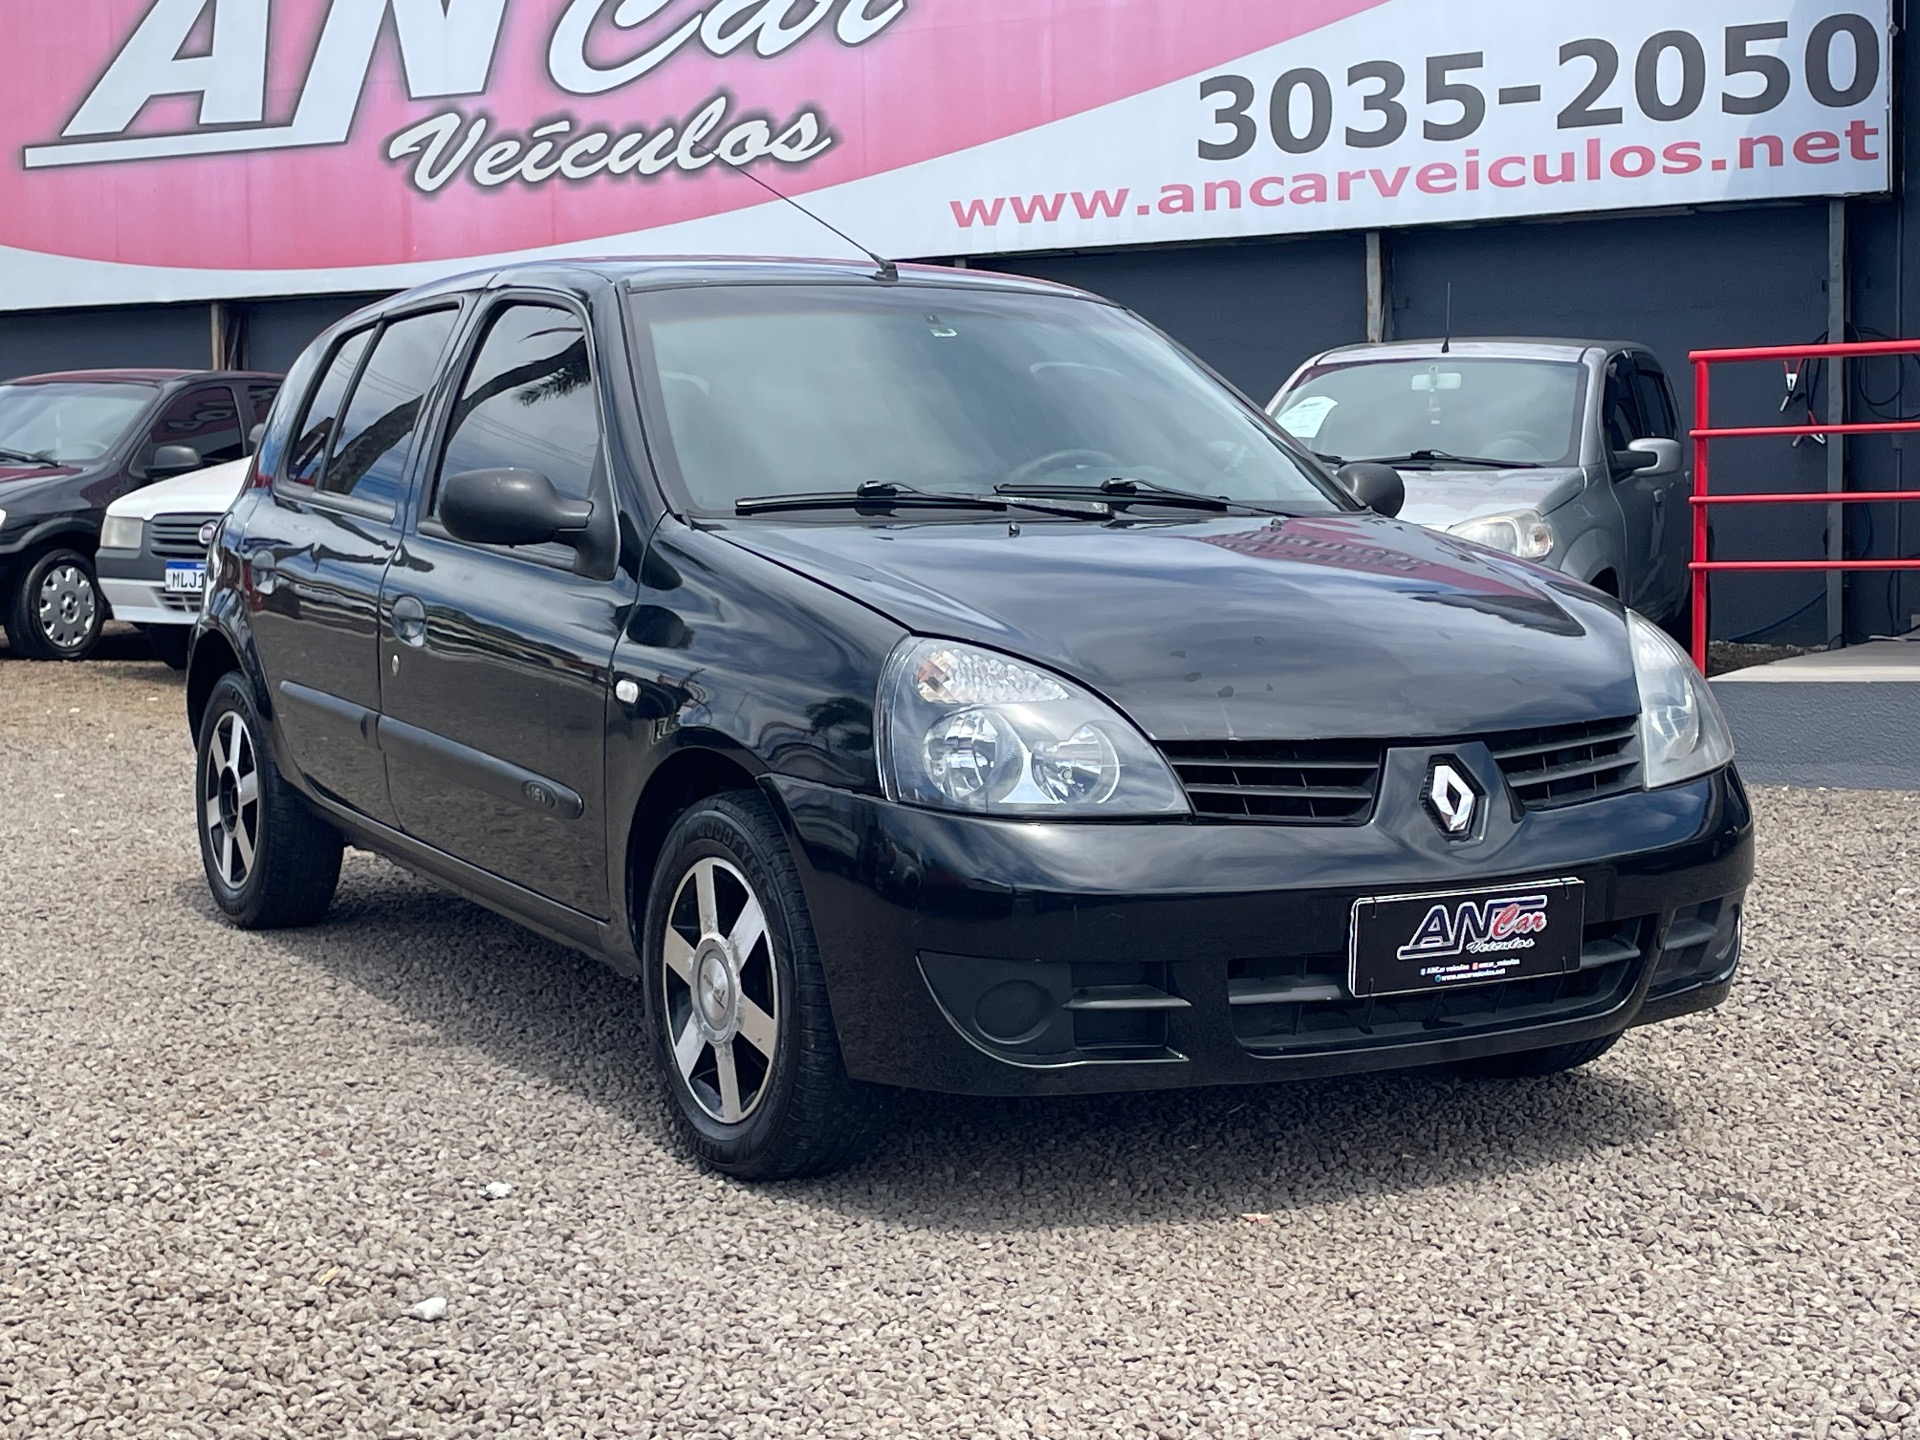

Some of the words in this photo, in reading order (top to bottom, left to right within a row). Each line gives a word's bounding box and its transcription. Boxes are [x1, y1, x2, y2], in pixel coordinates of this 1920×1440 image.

[1197, 13, 1880, 161] 3035-2050
[388, 97, 832, 192] Veículos
[949, 119, 1880, 229] www.ancarveiculos.net
[1397, 895, 1548, 960] AN
[1491, 903, 1548, 938] Car
